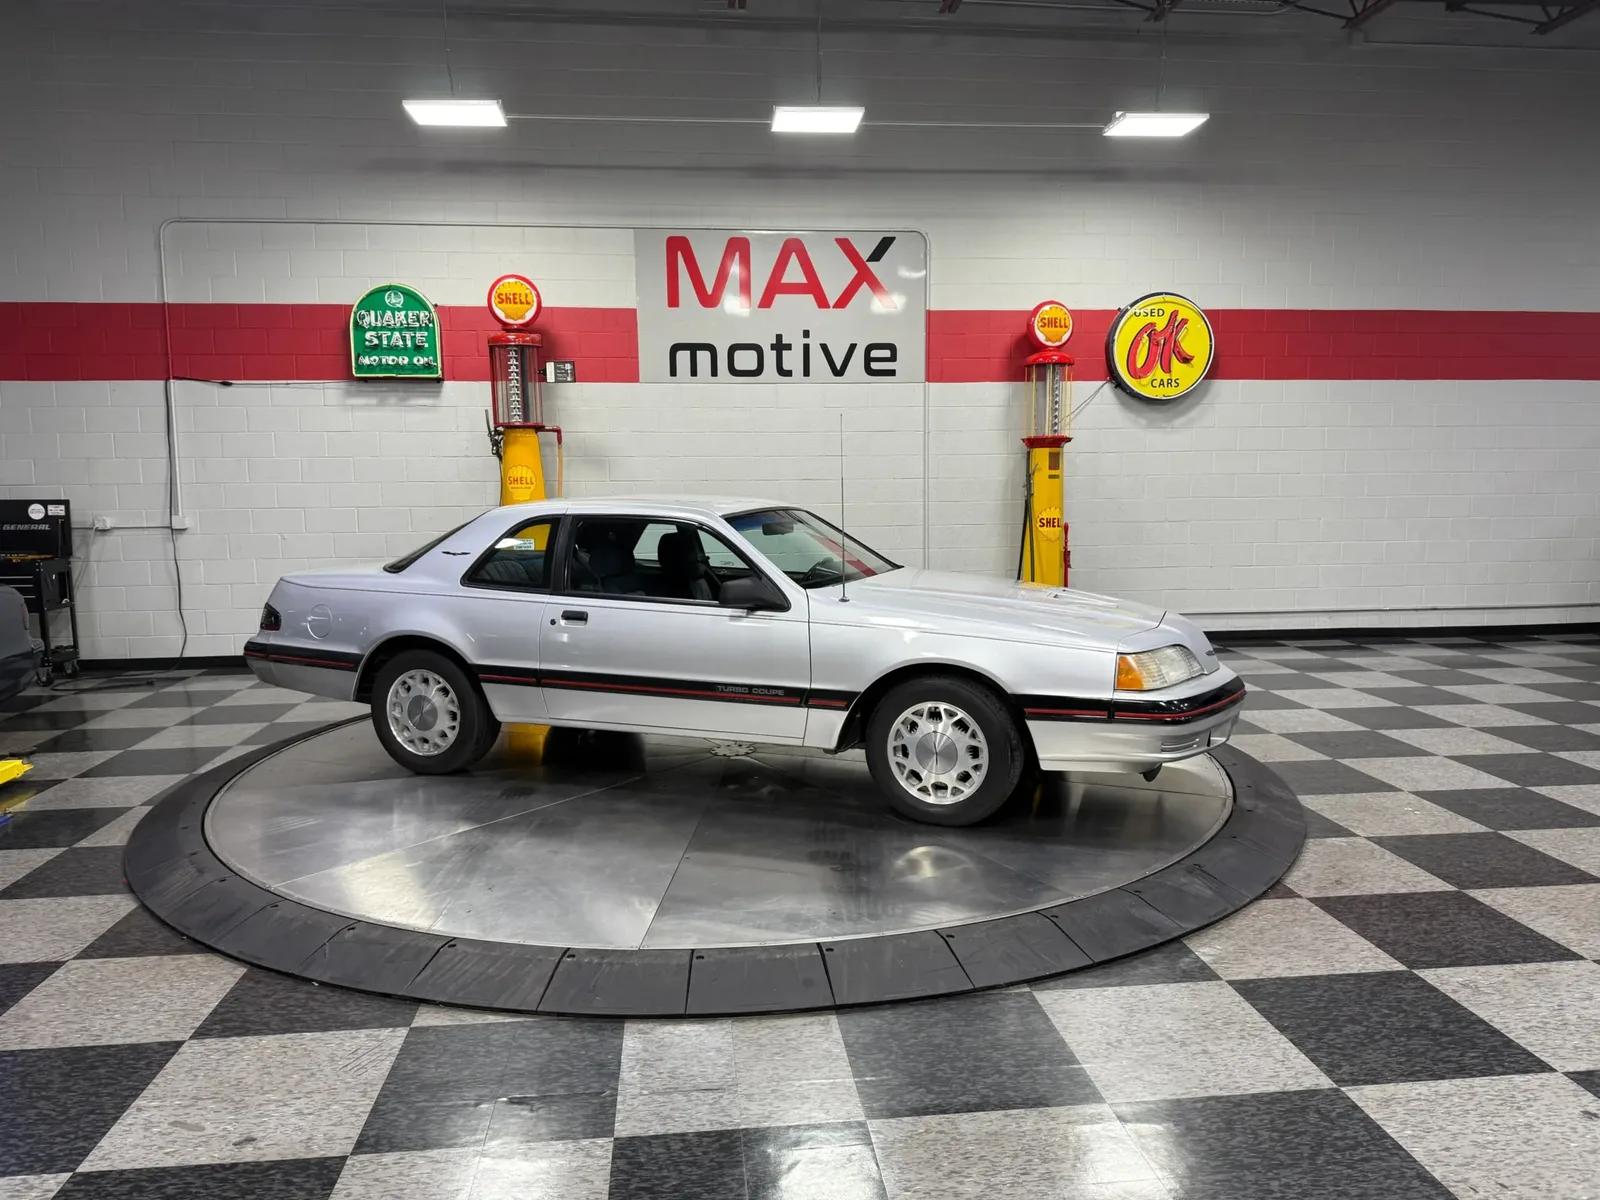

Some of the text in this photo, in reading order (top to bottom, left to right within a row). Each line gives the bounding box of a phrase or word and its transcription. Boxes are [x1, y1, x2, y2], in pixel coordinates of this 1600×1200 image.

[665, 235, 897, 309] MAX
[497, 292, 531, 305] SHELL
[356, 309, 433, 328] QUAKER
[1133, 307, 1165, 318] USED
[1039, 316, 1068, 329] SHELL
[364, 331, 429, 348] STATE
[1127, 309, 1195, 380] OK
[669, 329, 897, 378] motive
[358, 355, 409, 366] MOTOR
[1151, 377, 1180, 389] CARS
[507, 475, 535, 486] SHELL
[2, 523, 51, 531] GENERAL
[1038, 517, 1061, 528] SHEL
[716, 685, 785, 696] TURBO COUPE
